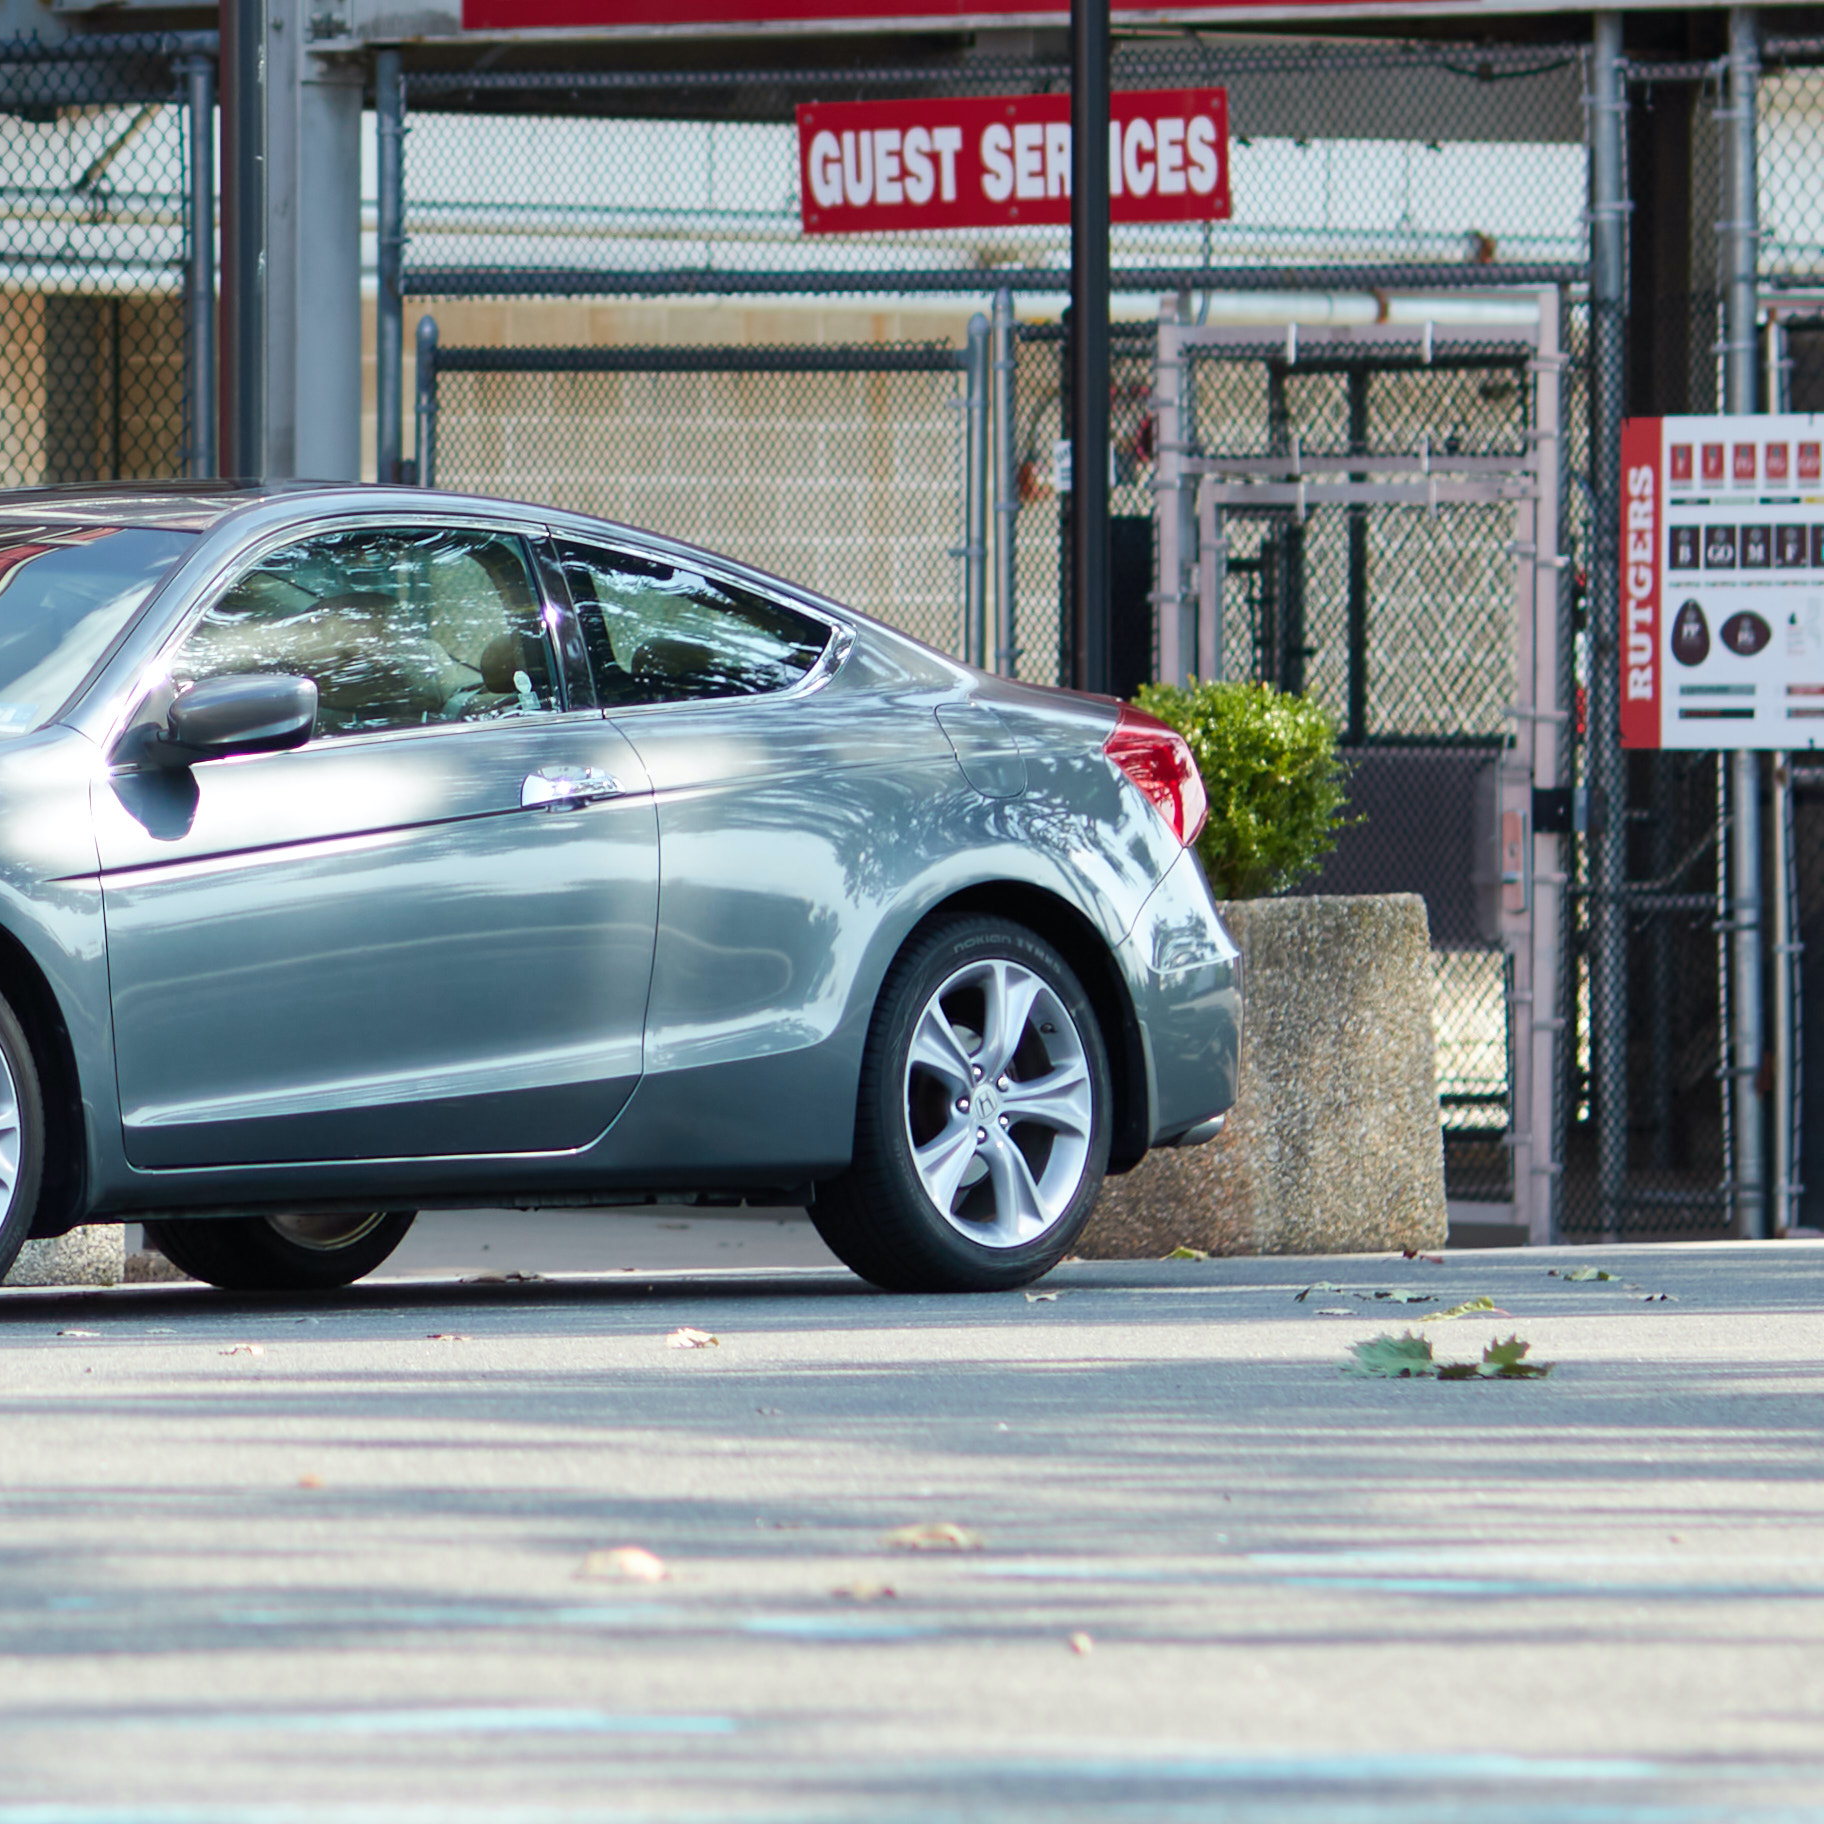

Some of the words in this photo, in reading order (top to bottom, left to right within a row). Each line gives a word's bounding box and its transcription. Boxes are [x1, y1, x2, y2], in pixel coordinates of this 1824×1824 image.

[808, 125, 962, 208] GUEST
[980, 115, 1219, 202] SERICES
[1625, 464, 1654, 703] RUTGERS
